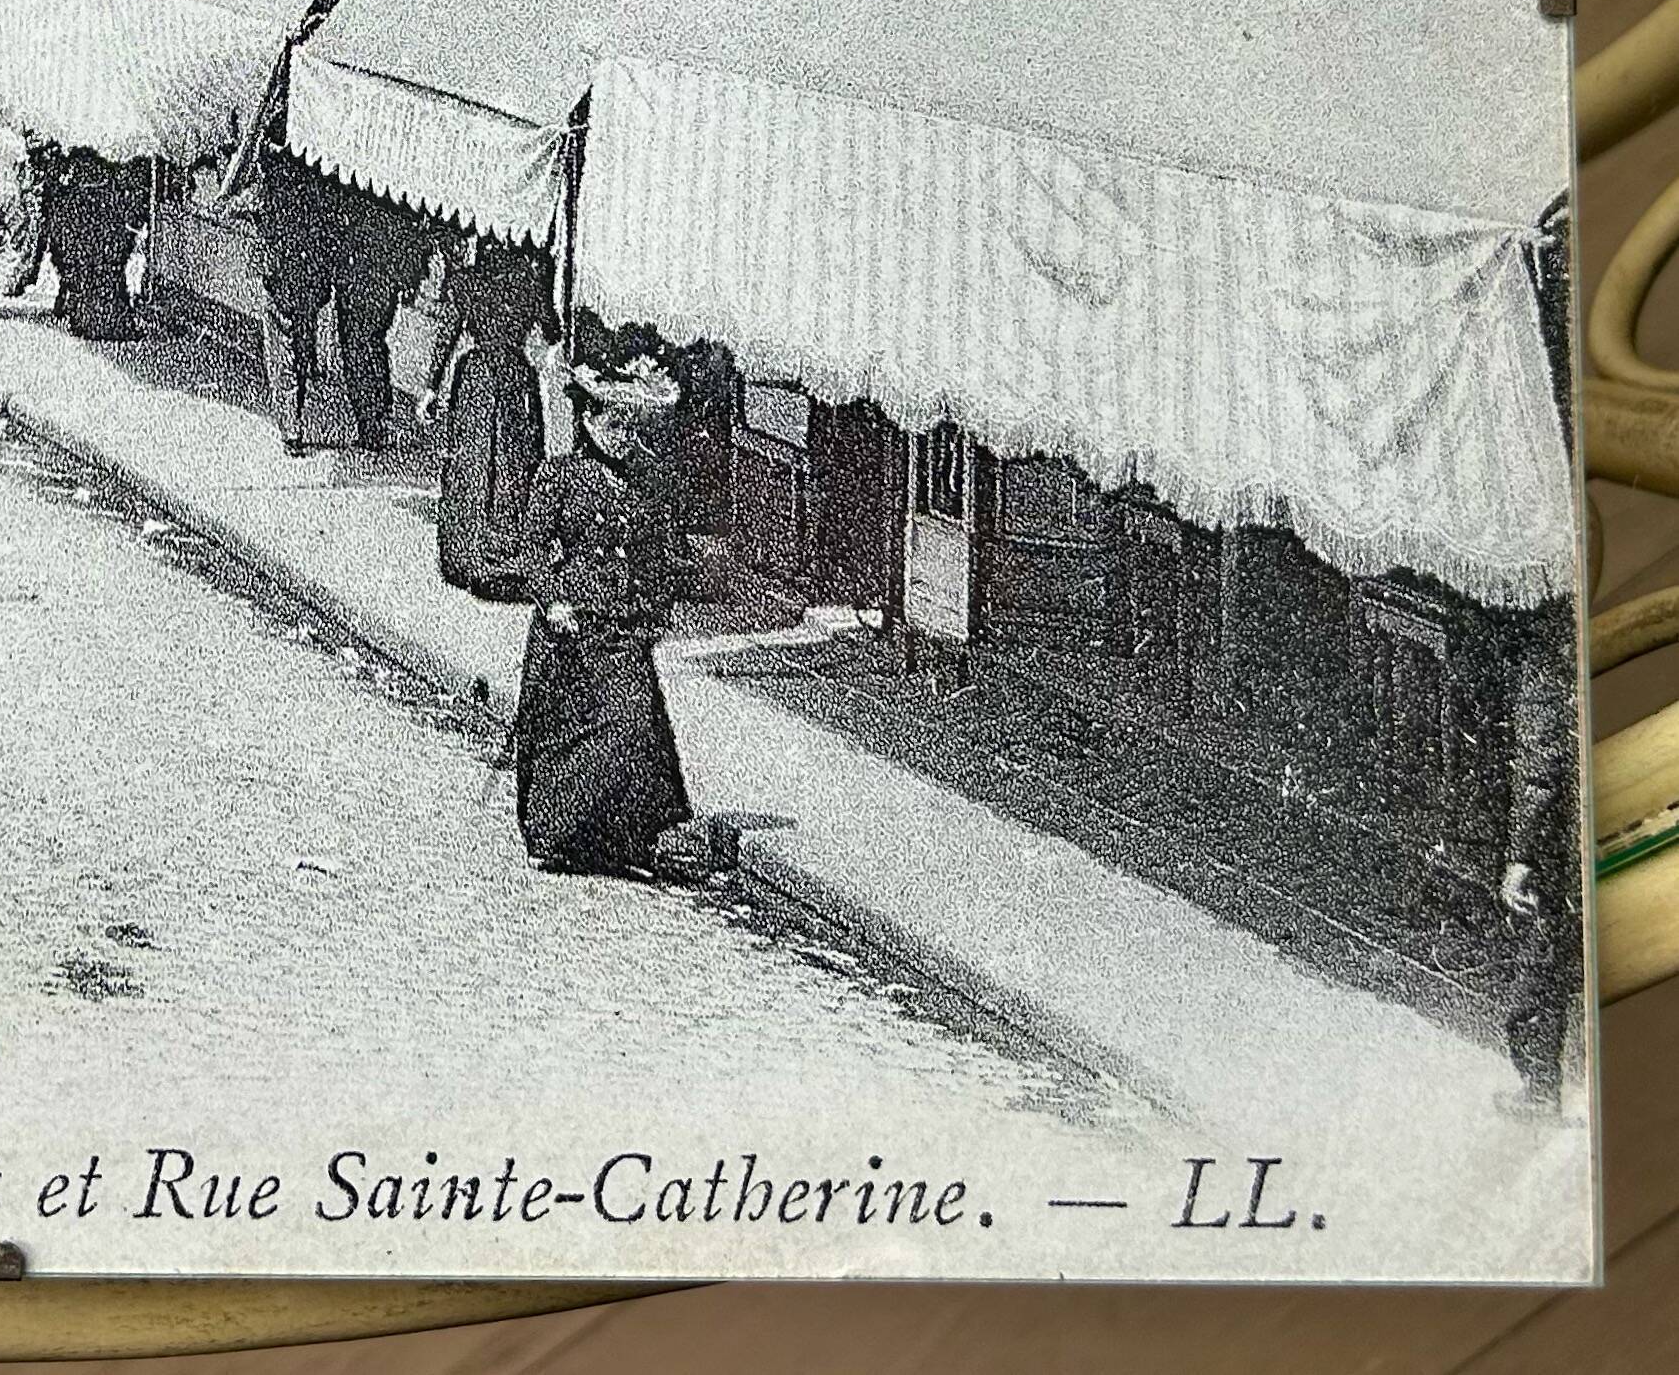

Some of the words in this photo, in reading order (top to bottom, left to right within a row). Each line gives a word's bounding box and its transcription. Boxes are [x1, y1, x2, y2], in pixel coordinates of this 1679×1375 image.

[36, 1154, 104, 1219] et
[132, 1147, 281, 1221] Rue
[314, 1150, 994, 1230] Sainte-Catherine.
[1170, 1156, 1328, 1231] LL.
